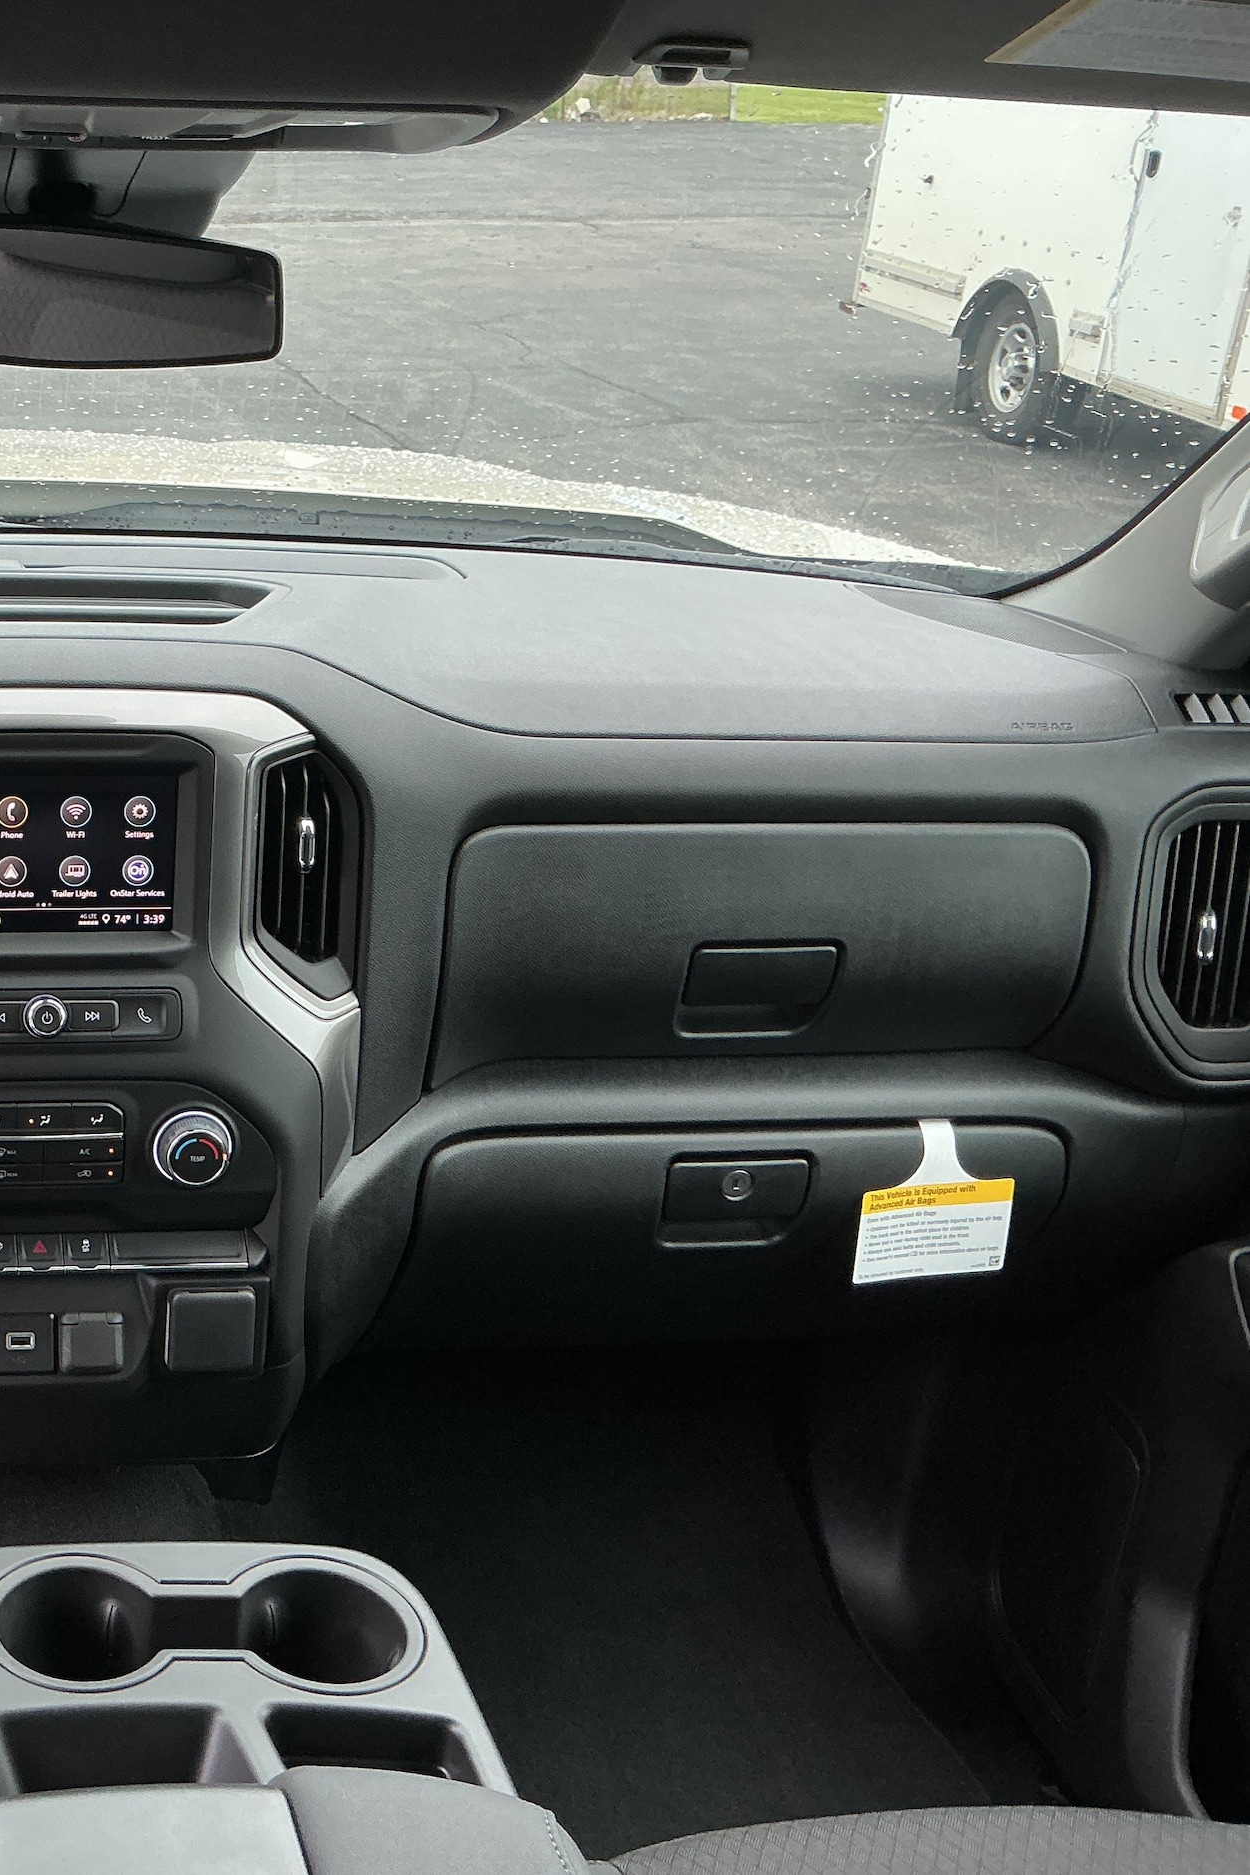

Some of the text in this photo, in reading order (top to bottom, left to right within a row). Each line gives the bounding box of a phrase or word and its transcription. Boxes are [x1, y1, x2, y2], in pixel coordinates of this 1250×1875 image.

[1011, 722, 1073, 731] AIRBAG
[0, 831, 24, 840] Phone
[66, 831, 86, 839] Wi-Fi
[124, 830, 154, 840] Settings
[17, 890, 35, 898] Auto
[51, 889, 97, 899] Trailer Lights
[110, 889, 165, 897] OnStar Services
[143, 914, 165, 924] 3:39
[79, 1148, 91, 1156] A/C
[870, 1185, 976, 1202] This Vehicle is Equipped with
[869, 1197, 937, 1211] Advanced Air Bags
